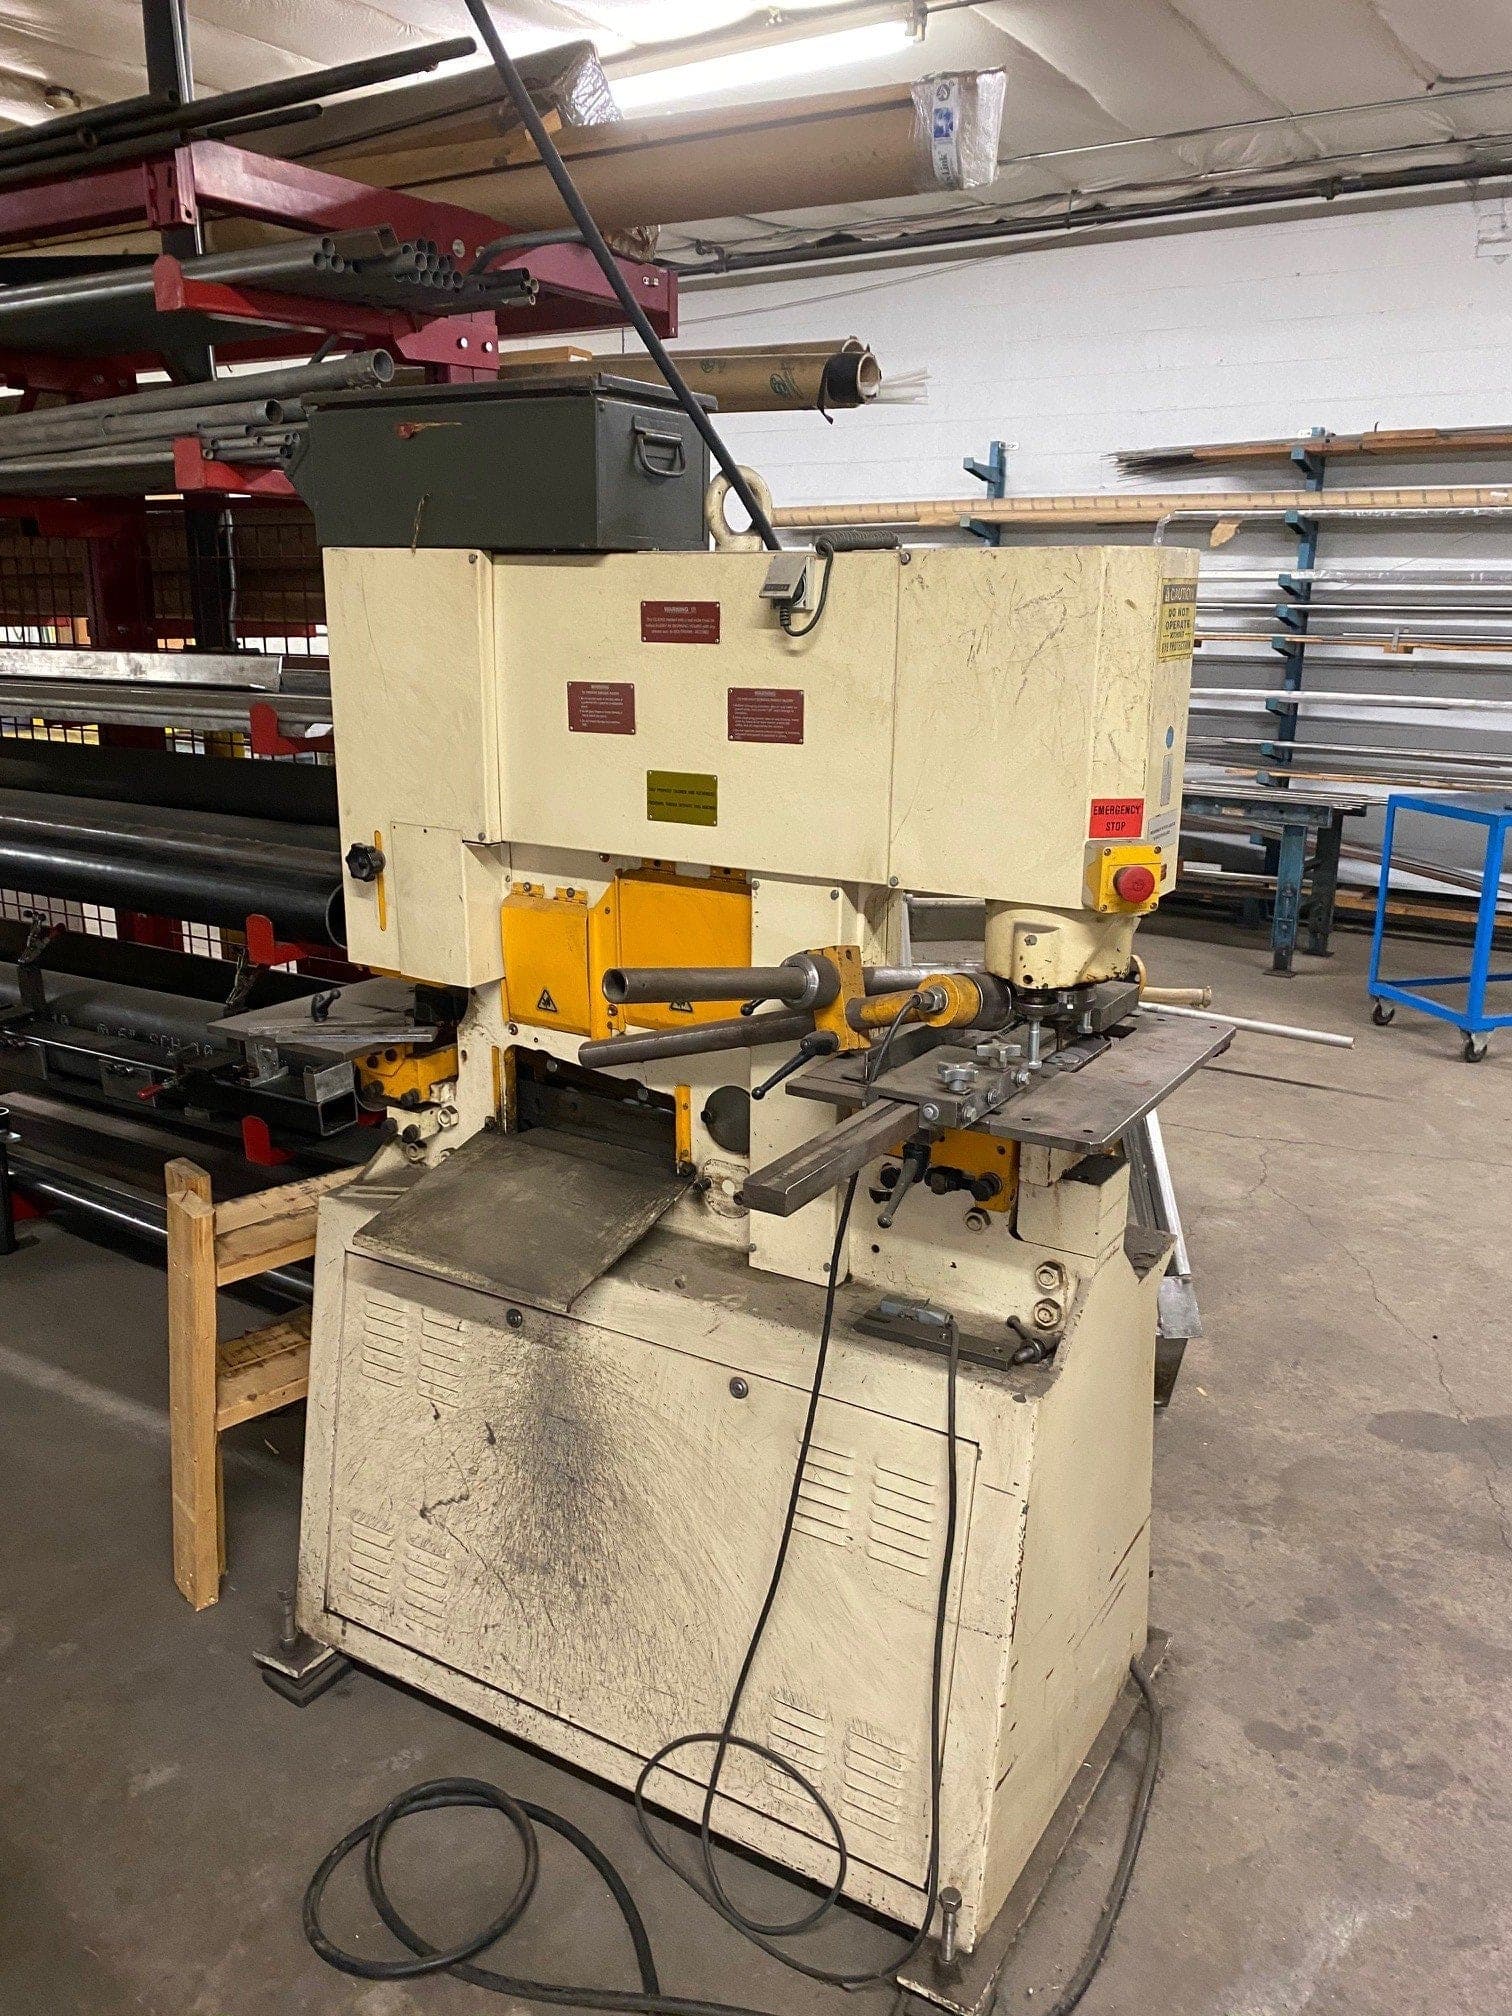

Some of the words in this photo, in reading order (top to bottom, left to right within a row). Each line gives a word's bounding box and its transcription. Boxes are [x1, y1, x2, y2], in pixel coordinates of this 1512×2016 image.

[1168, 608, 1177, 618] DO
[1177, 607, 1190, 617] NOT
[1166, 620, 1190, 630] OPERATE
[1093, 805, 1141, 815] EMERGENCY
[1106, 822, 1126, 831] STOP
